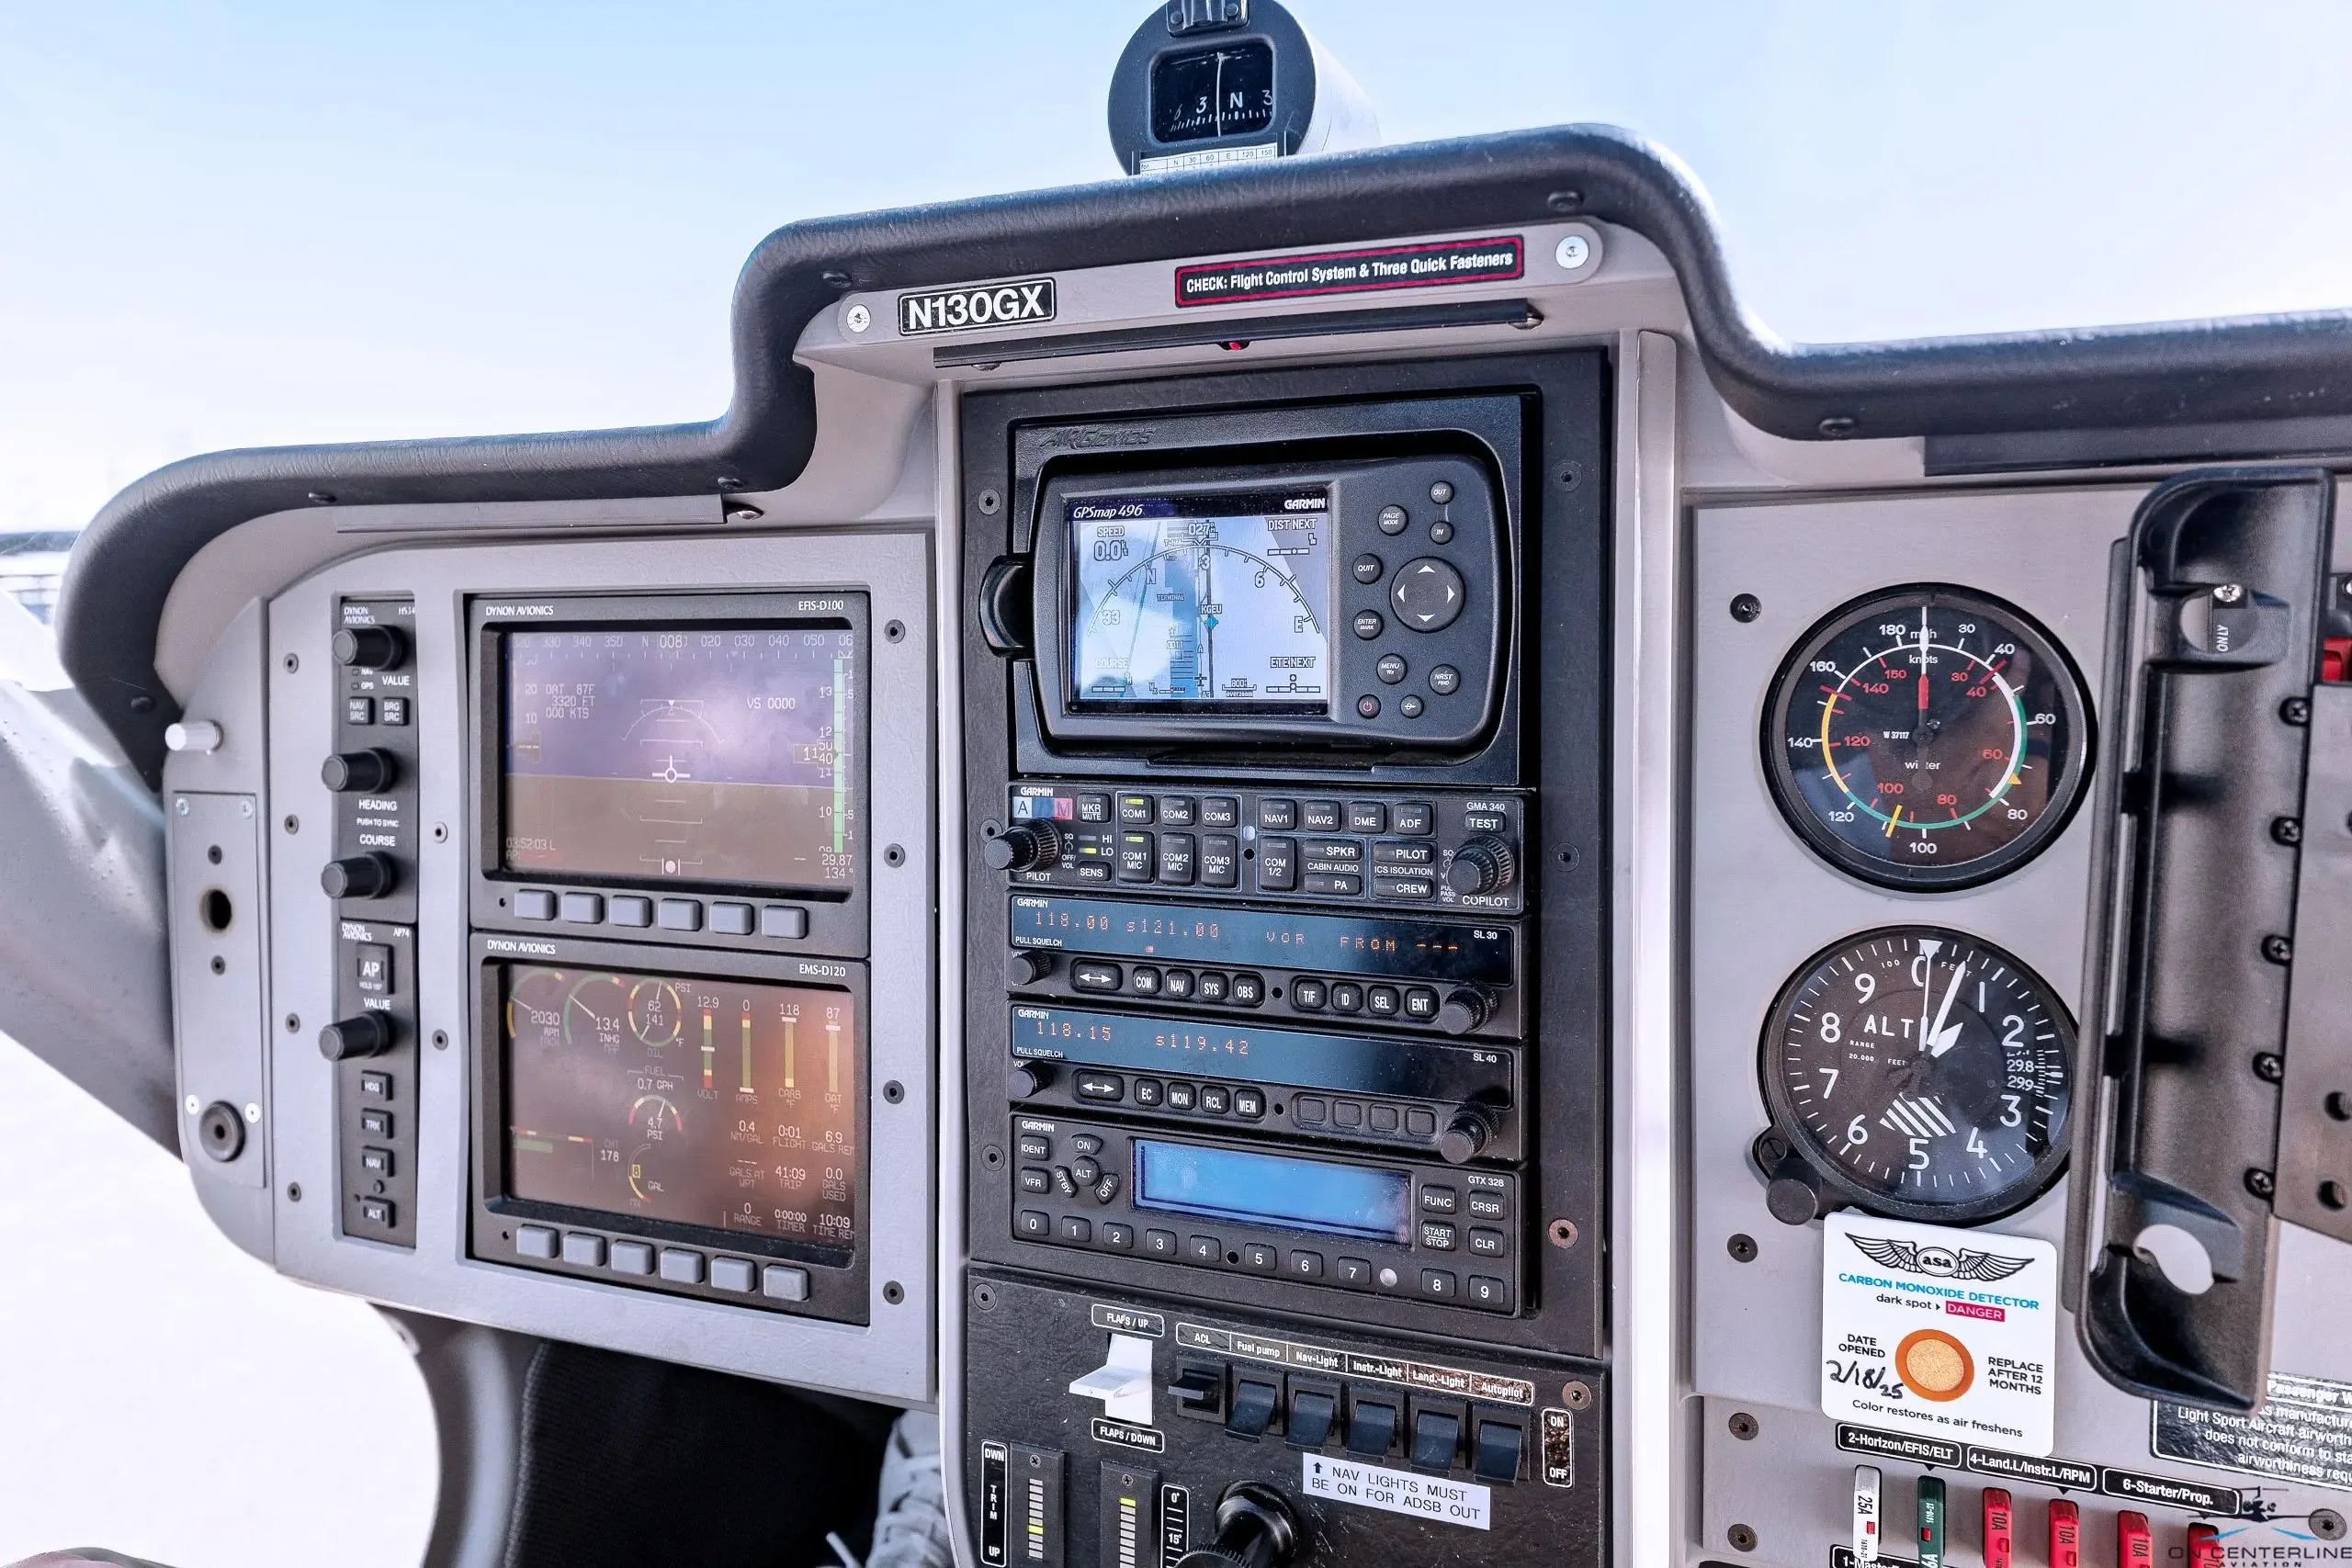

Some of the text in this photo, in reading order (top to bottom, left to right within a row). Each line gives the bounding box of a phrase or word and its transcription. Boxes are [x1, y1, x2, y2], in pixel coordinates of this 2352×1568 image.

[1196, 96, 1206, 113] 3
[1230, 93, 1242, 108] N
[1187, 253, 1513, 293] CHECK: Flight Control System & Three Quick Fasteners
[910, 285, 1044, 329] N130GX
[1284, 499, 1325, 510] GARMIN
[1073, 504, 1142, 519] GPSmap 496
[1268, 519, 1317, 530] DIST NEXT
[1097, 526, 1125, 536] SPEED
[486, 605, 553, 615] DYNON AVIONICS
[798, 601, 843, 611] EFIS-D100
[1879, 625, 1905, 636] 180
[1959, 624, 1975, 634] 30
[1995, 644, 2015, 655] 40
[1810, 661, 1835, 672] 160
[382, 676, 410, 685] VALUE
[820, 687, 832, 698] 13
[384, 702, 400, 710] BRG
[747, 698, 796, 709] VS 0000
[1845, 736, 1870, 747] 120
[1021, 787, 1053, 796] GARMIN
[1877, 783, 1903, 794] 100
[359, 800, 397, 811] HEADING
[1082, 804, 1101, 812] MKR
[1467, 802, 1487, 810] GMA
[1265, 814, 1288, 823] NAV1
[1828, 811, 1854, 822] 120
[2007, 809, 2028, 820] 80
[1355, 818, 1375, 826] DME
[1400, 819, 1421, 828] ADF
[1470, 819, 1498, 829] TEST
[360, 835, 395, 846] COURSE
[1327, 847, 1355, 856] SPKR
[1396, 850, 1427, 859] PILOT
[822, 854, 853, 865] 29.87
[1026, 873, 1051, 882] PILOT
[1080, 868, 1102, 877] SENS
[1396, 885, 1427, 893] CREW
[1017, 898, 1048, 908] GARMIN
[1463, 896, 1509, 907] COPILOT
[488, 940, 555, 953] DYNON AVIONICS
[363, 963, 379, 976] AP
[799, 964, 845, 976] EMS-D120
[675, 982, 691, 992] PSI
[1136, 976, 1151, 988] COM
[1170, 981, 1184, 992] NAV
[1204, 983, 1218, 995] SYS
[1855, 974, 1875, 1004] 9
[364, 998, 390, 1010] VALUE
[698, 996, 718, 1008] 12.9
[1342, 993, 1349, 1005] ID
[1374, 997, 1389, 1009] SEL
[1412, 998, 1428, 1011] ENT
[531, 1011, 560, 1025] 2030
[1018, 1010, 1048, 1020] GARMIN
[596, 1018, 619, 1031] 13.4
[1821, 1012, 1840, 1043] 8
[2002, 1015, 2024, 1047] 2
[1819, 1068, 1838, 1099] 7
[1172, 1093, 1188, 1105] MON
[1206, 1097, 1221, 1109] RCL
[1238, 1100, 1256, 1112] MEM
[2000, 1095, 2021, 1127] 3
[739, 1120, 755, 1132] 0.4
[778, 1125, 800, 1138] 0:01
[1022, 1121, 1054, 1132] GARMIN
[1847, 1114, 1868, 1145] 6
[826, 1131, 842, 1144] 6.9
[1966, 1127, 1987, 1158] 4
[1909, 1139, 1929, 1169] 5
[367, 1158, 380, 1168] NAV
[775, 1166, 806, 1179] 41:09
[1424, 1196, 1452, 1207] FUNC
[368, 1208, 381, 1218] ALT
[820, 1213, 850, 1227] 10:09
[1114, 1232, 1120, 1243] 2
[1156, 1238, 1163, 1249] 3
[1199, 1245, 1206, 1256] 4
[1255, 1253, 1262, 1264] 5
[1922, 1255, 1952, 1269] asa
[1302, 1260, 1308, 1271] 6
[1350, 1268, 1356, 1279] 7
[1433, 1280, 1441, 1292] 8
[1480, 1286, 1489, 1298] 9
[1839, 1273, 2039, 1309] CARBON MONOXIDE DETECTOR
[1876, 1294, 2003, 1319] dark spot DANGER
[1194, 1333, 1210, 1344] ACL
[1848, 1334, 1876, 1346] DATE
[1238, 1341, 1280, 1358] Fuel pump
[1838, 1343, 1885, 1358] OPENED
[1988, 1357, 2043, 1372] REPLACE
[1826, 1360, 1904, 1399] 2/18/25
[1988, 1368, 2042, 1383] AFTER 12
[1481, 1382, 1523, 1398] Autopilot
[1989, 1379, 2041, 1394] MONTHS
[1551, 1416, 1564, 1427] ON
[1852, 1400, 2022, 1437] Color restores as air freshens
[1849, 1432, 1952, 1459] 2-Horizon/EFIS/ELT
[2205, 1429, 2331, 1462] does not conform to
[985, 1449, 1004, 1462] DWN
[2238, 1453, 2324, 1478] airworthiness
[1549, 1468, 1567, 1480] OFF
[1332, 1467, 1467, 1501] NAV LIGHTS MUST
[1312, 1478, 1480, 1519] BE ON FOR ADSB OUT
[2123, 1479, 2213, 1506] 6-Starter/Prop.
[1858, 1495, 1872, 1514] 25A
[1992, 1512, 2007, 1530] 10A
[2059, 1527, 2075, 1544] 10A
[2132, 1538, 2148, 1557] 10A
